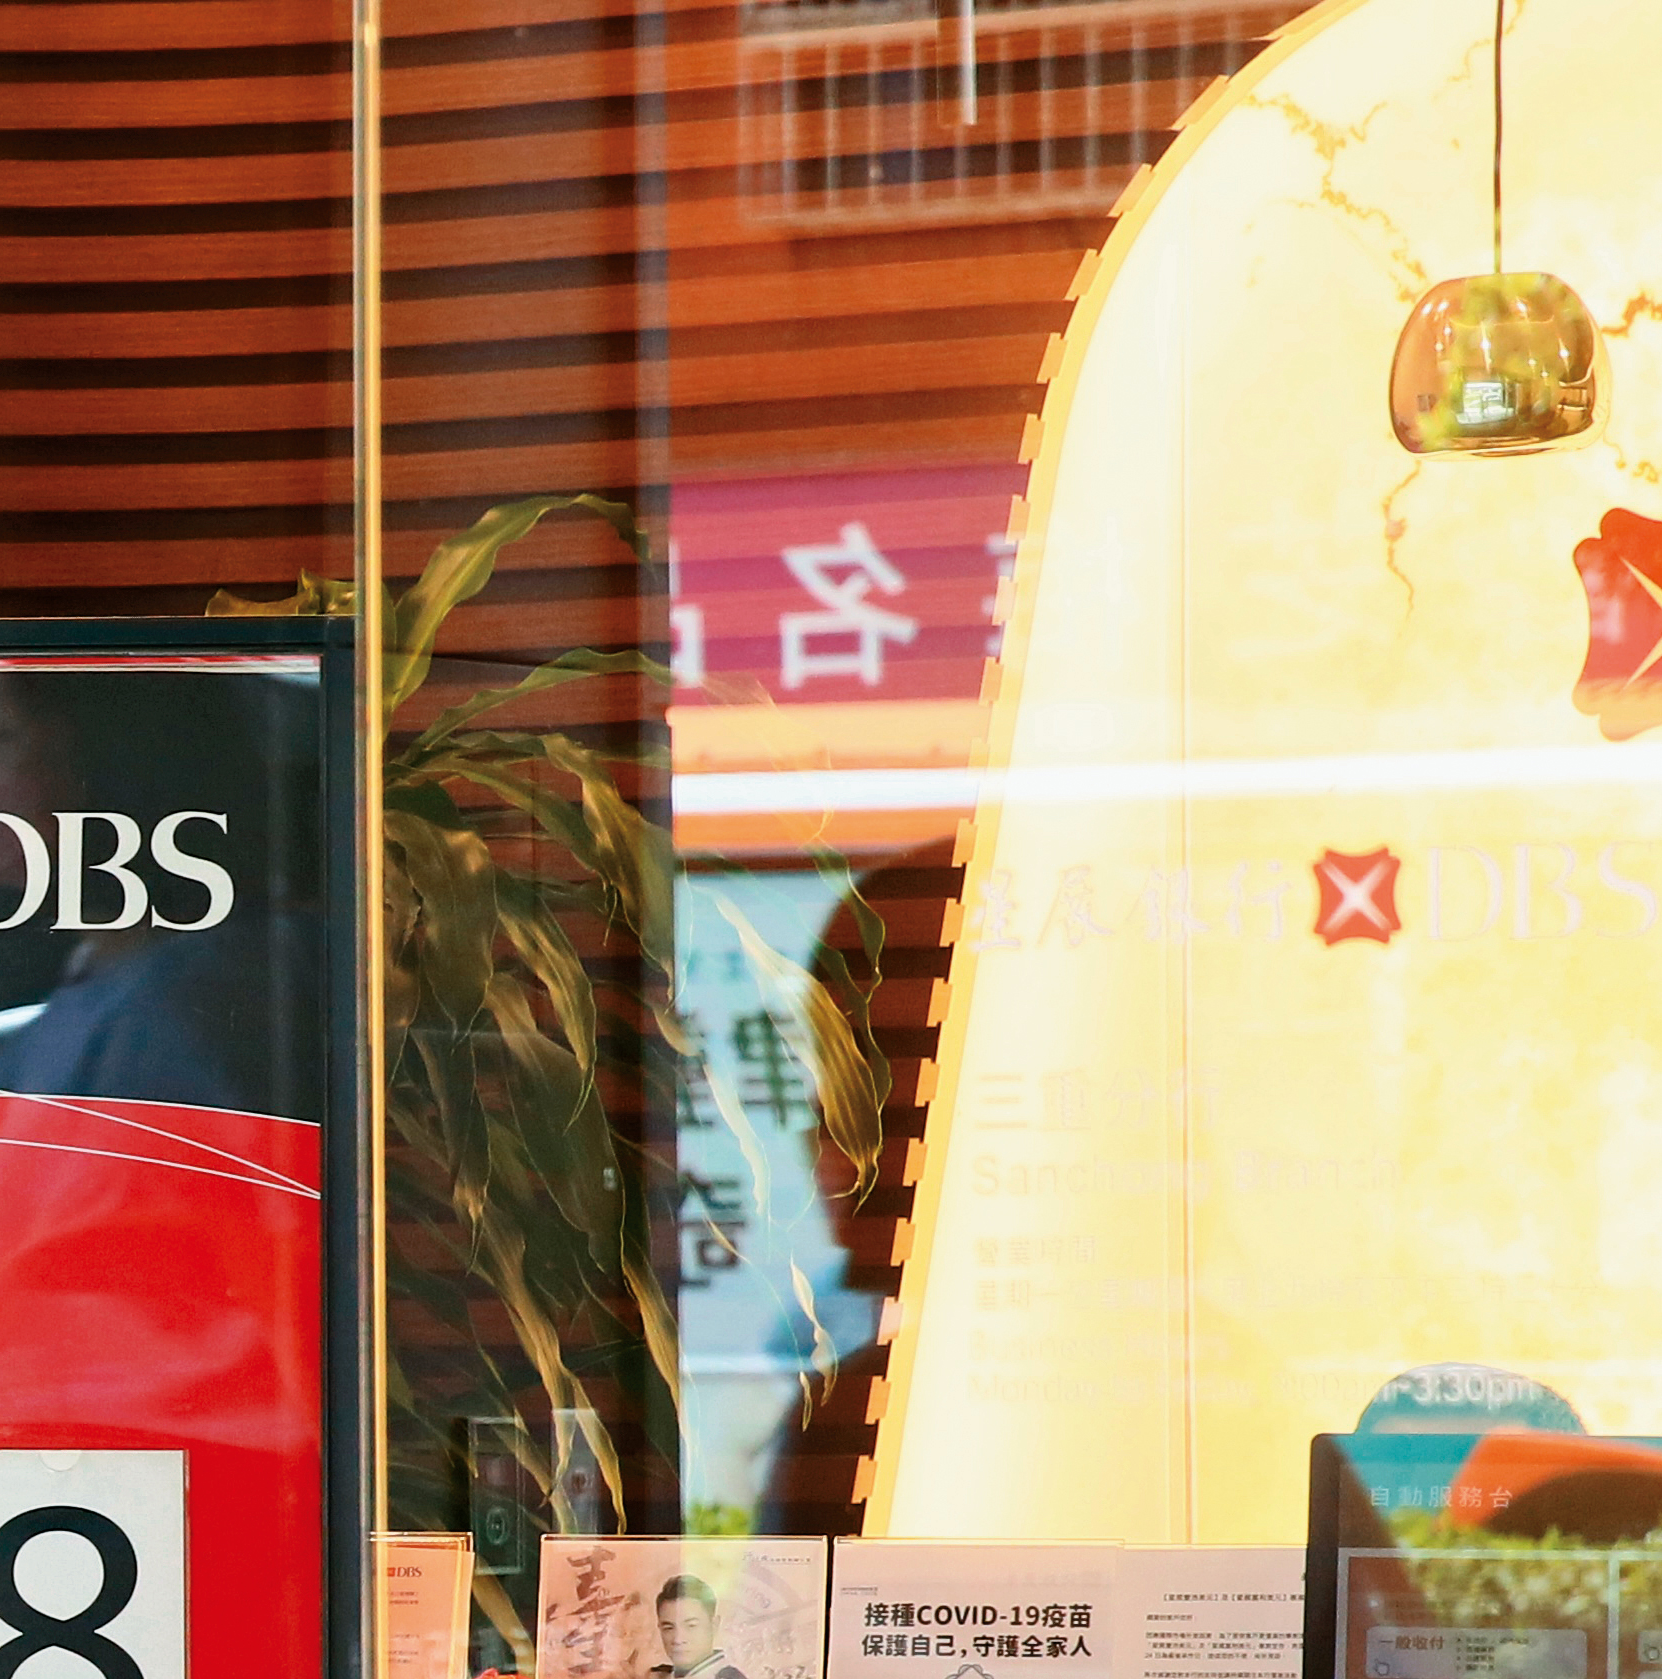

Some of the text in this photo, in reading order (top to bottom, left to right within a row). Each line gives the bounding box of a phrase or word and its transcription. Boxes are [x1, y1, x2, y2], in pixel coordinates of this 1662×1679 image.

[1370, 1485, 1514, 1509] 自動服務台
[396, 1566, 423, 1578] DBS
[863, 1602, 1093, 1629] 接種COVID-19疫苗
